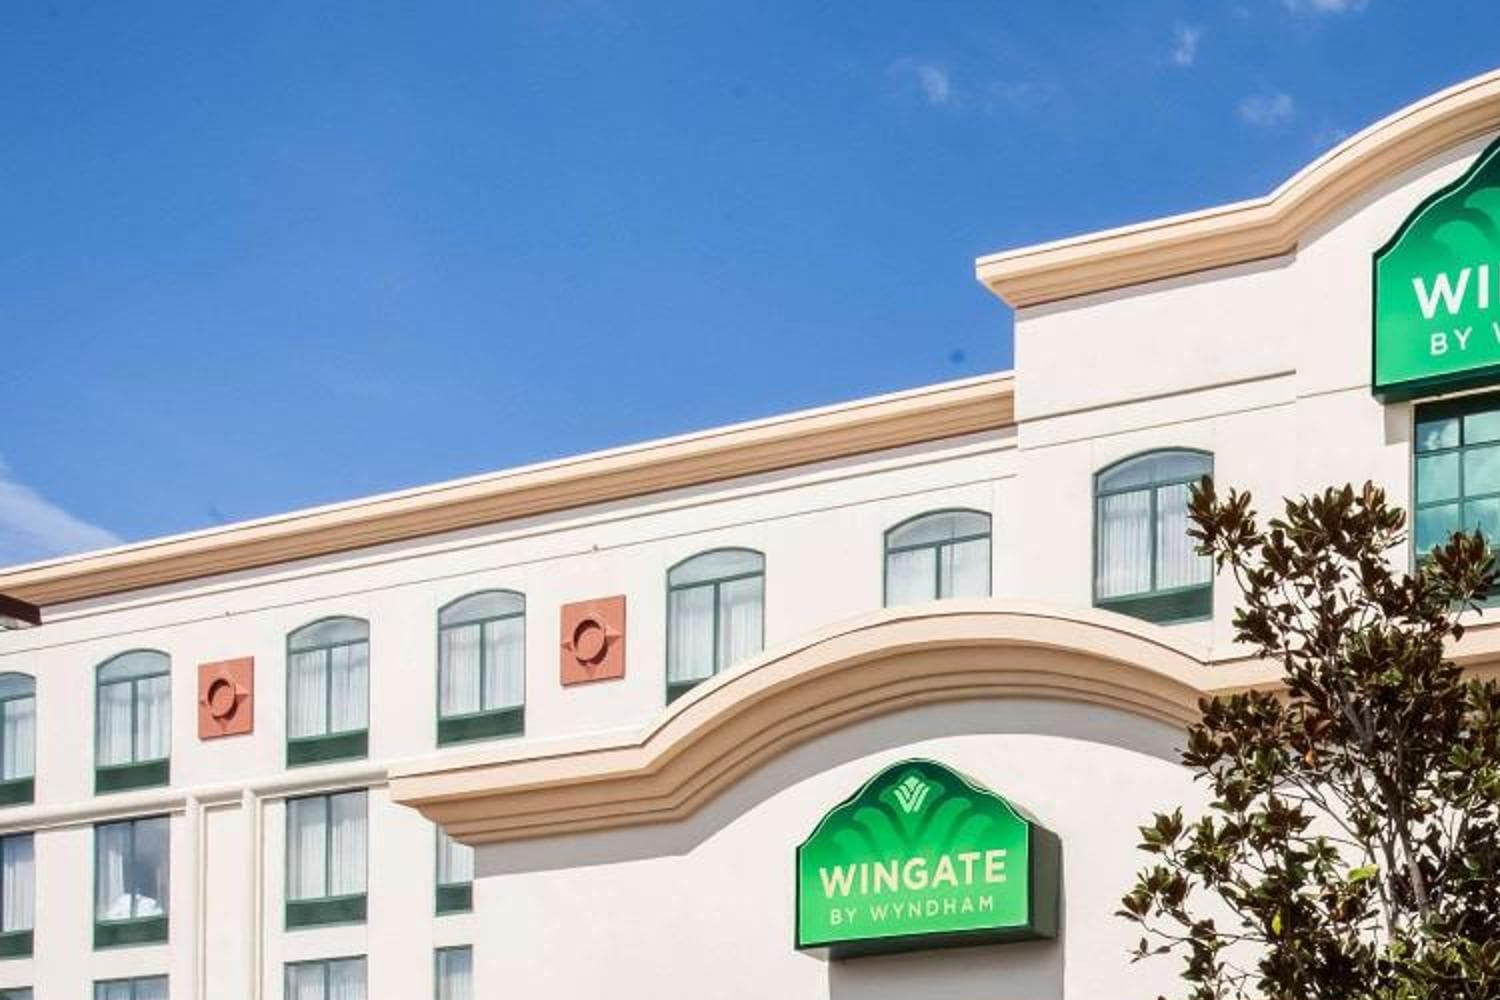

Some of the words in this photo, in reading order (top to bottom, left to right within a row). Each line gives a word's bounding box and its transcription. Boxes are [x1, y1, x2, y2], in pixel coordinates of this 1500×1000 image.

[1430, 326, 1473, 356] BY
[818, 849, 1008, 899] WINGATE
[830, 908, 857, 926] BY
[870, 895, 994, 922] WYNDHAM
